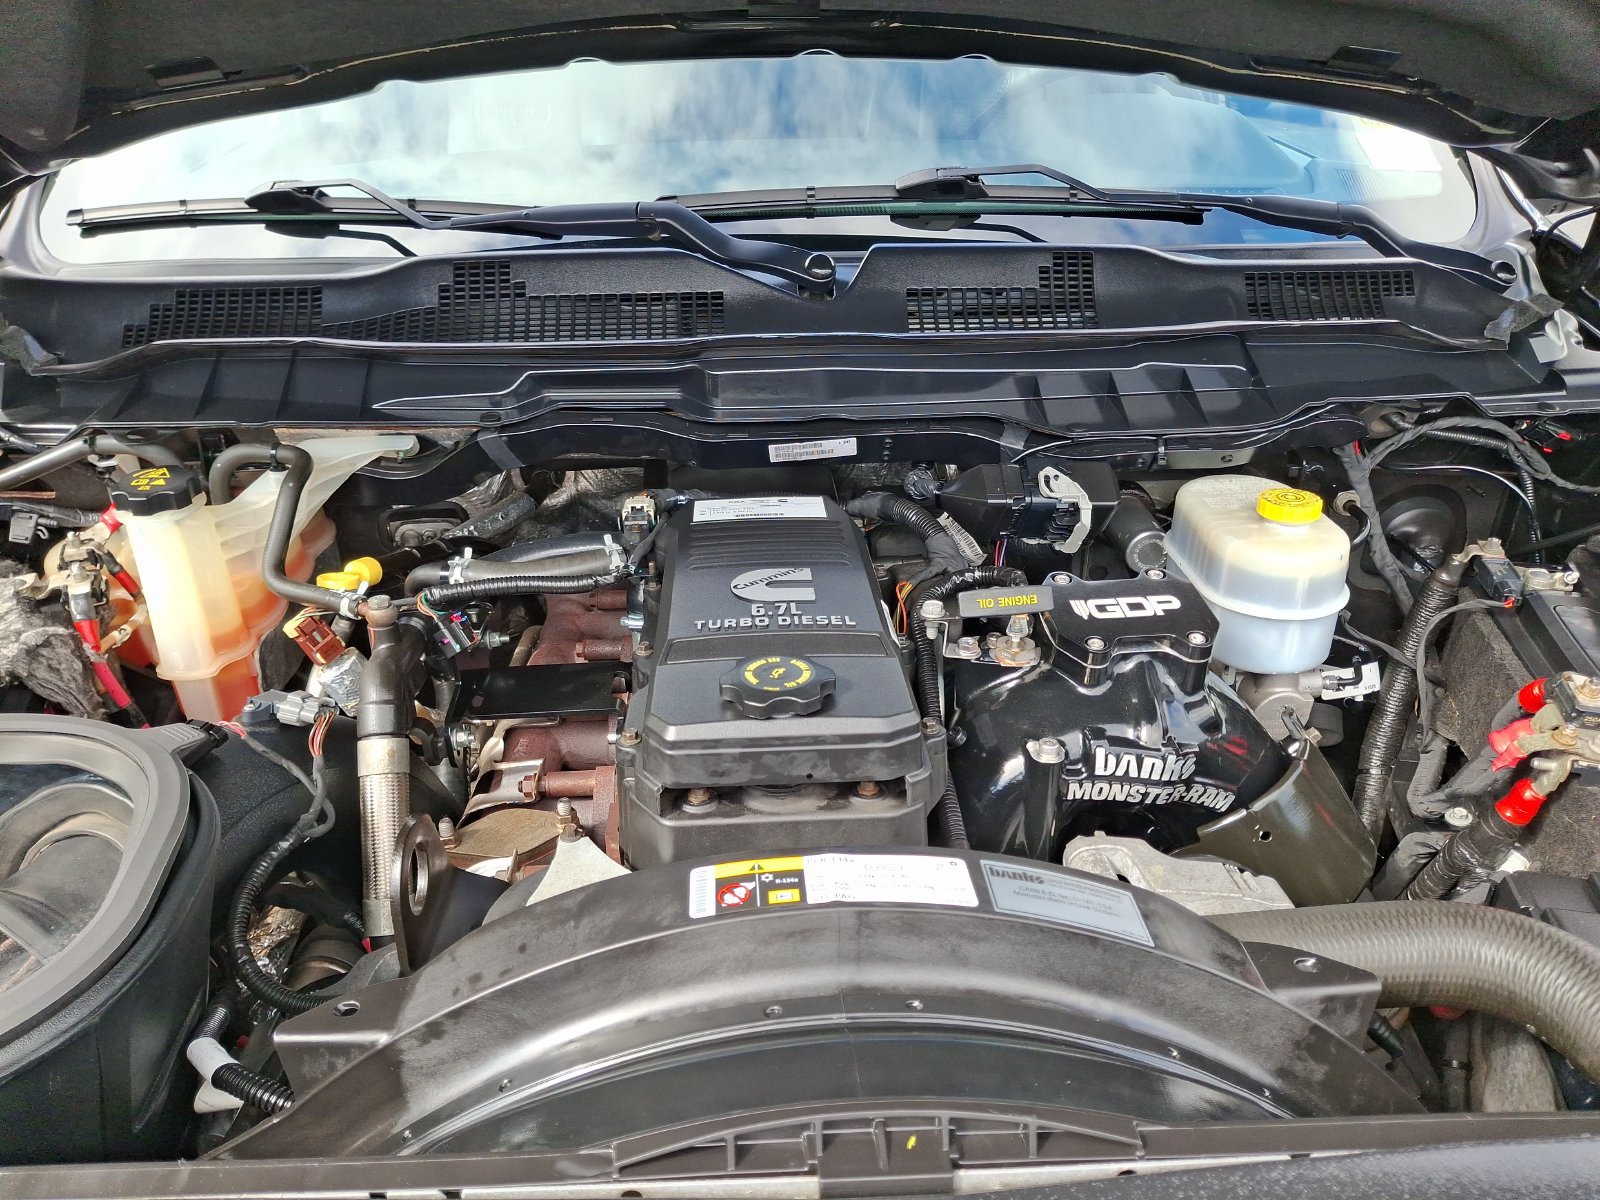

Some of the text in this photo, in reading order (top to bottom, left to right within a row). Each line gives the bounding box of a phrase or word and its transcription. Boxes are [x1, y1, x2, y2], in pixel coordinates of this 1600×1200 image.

[733, 567, 804, 590] Cummins
[751, 602, 802, 617] 6.7L
[976, 593, 1038, 609] ENGINE OIL
[1087, 594, 1182, 619] GDP
[694, 615, 857, 632] TURBO DIESEL
[1066, 780, 1237, 814] MONSTER-RAM
[989, 866, 1044, 884] banks
